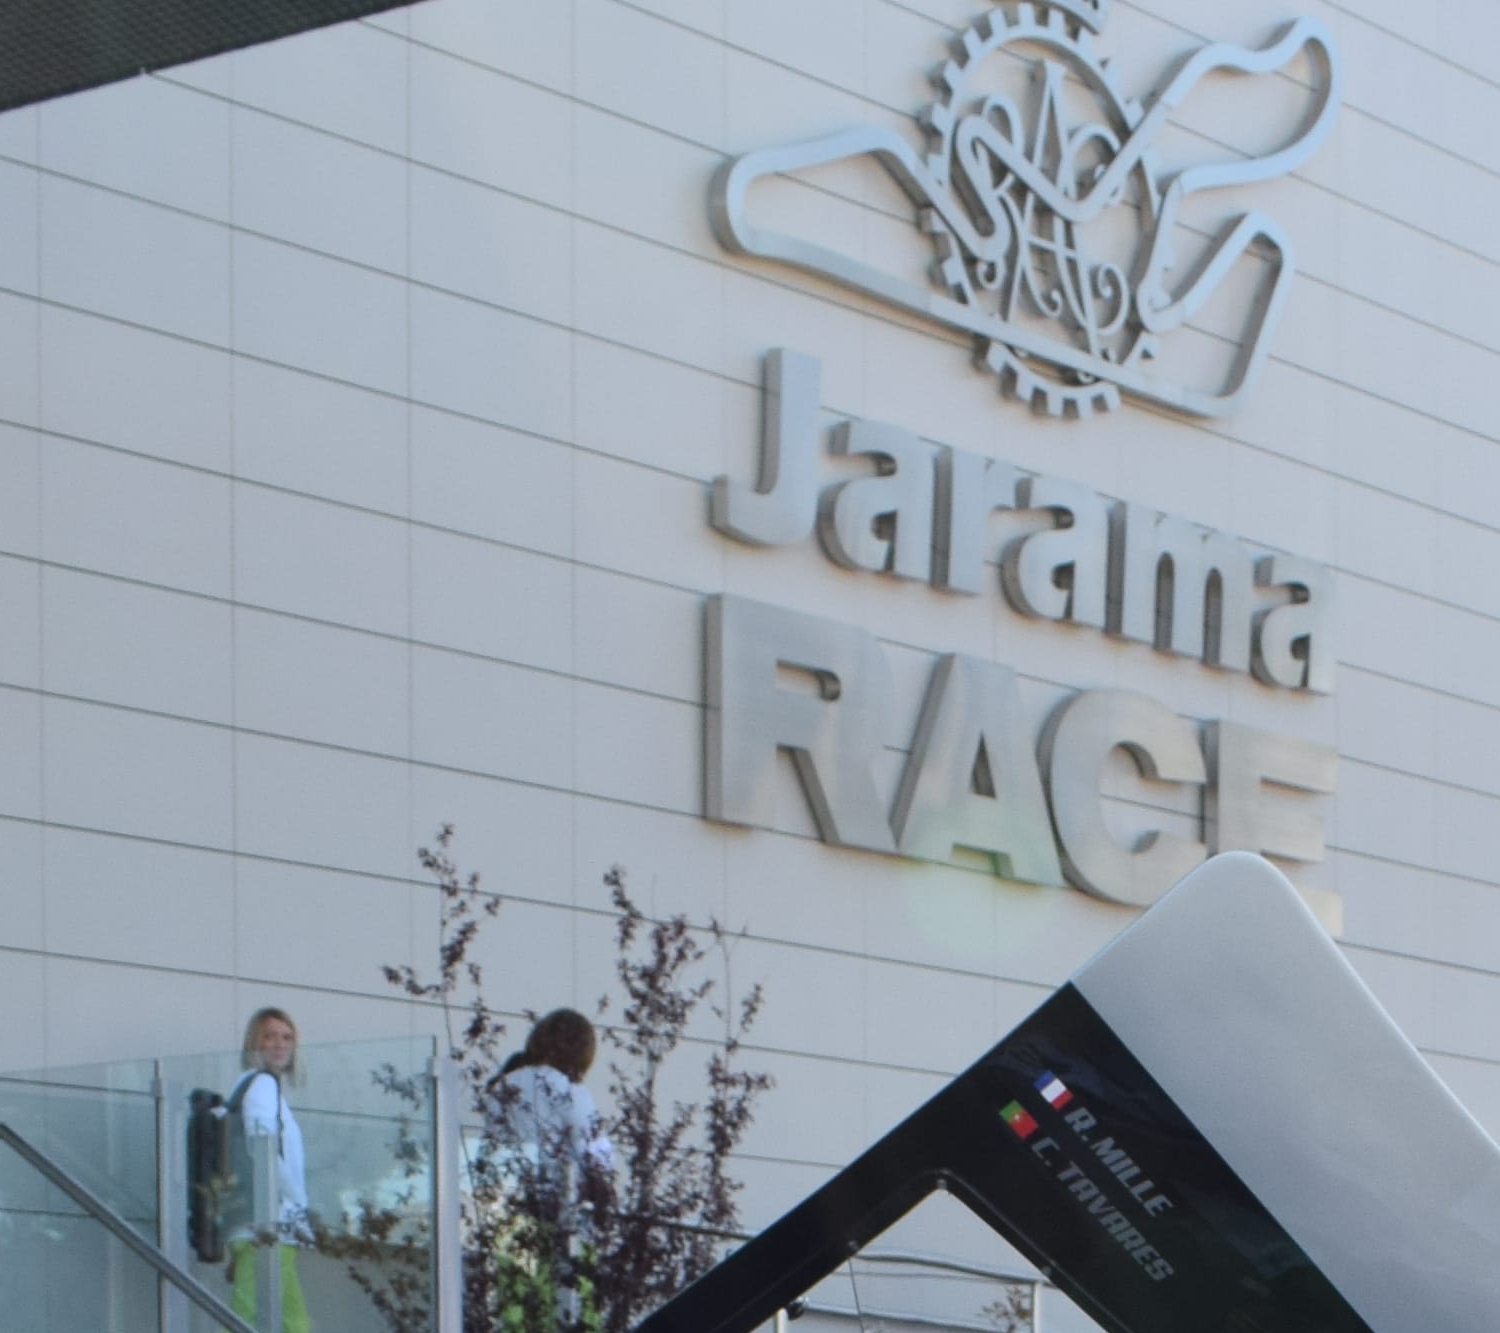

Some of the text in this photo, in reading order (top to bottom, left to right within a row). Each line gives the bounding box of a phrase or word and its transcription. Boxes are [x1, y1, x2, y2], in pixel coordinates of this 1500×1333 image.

[707, 346, 1336, 697] Jarama
[702, 592, 1343, 938] RACE
[1057, 1160, 1175, 1281] TAVARES
[1089, 1136, 1174, 1217] MILLE
